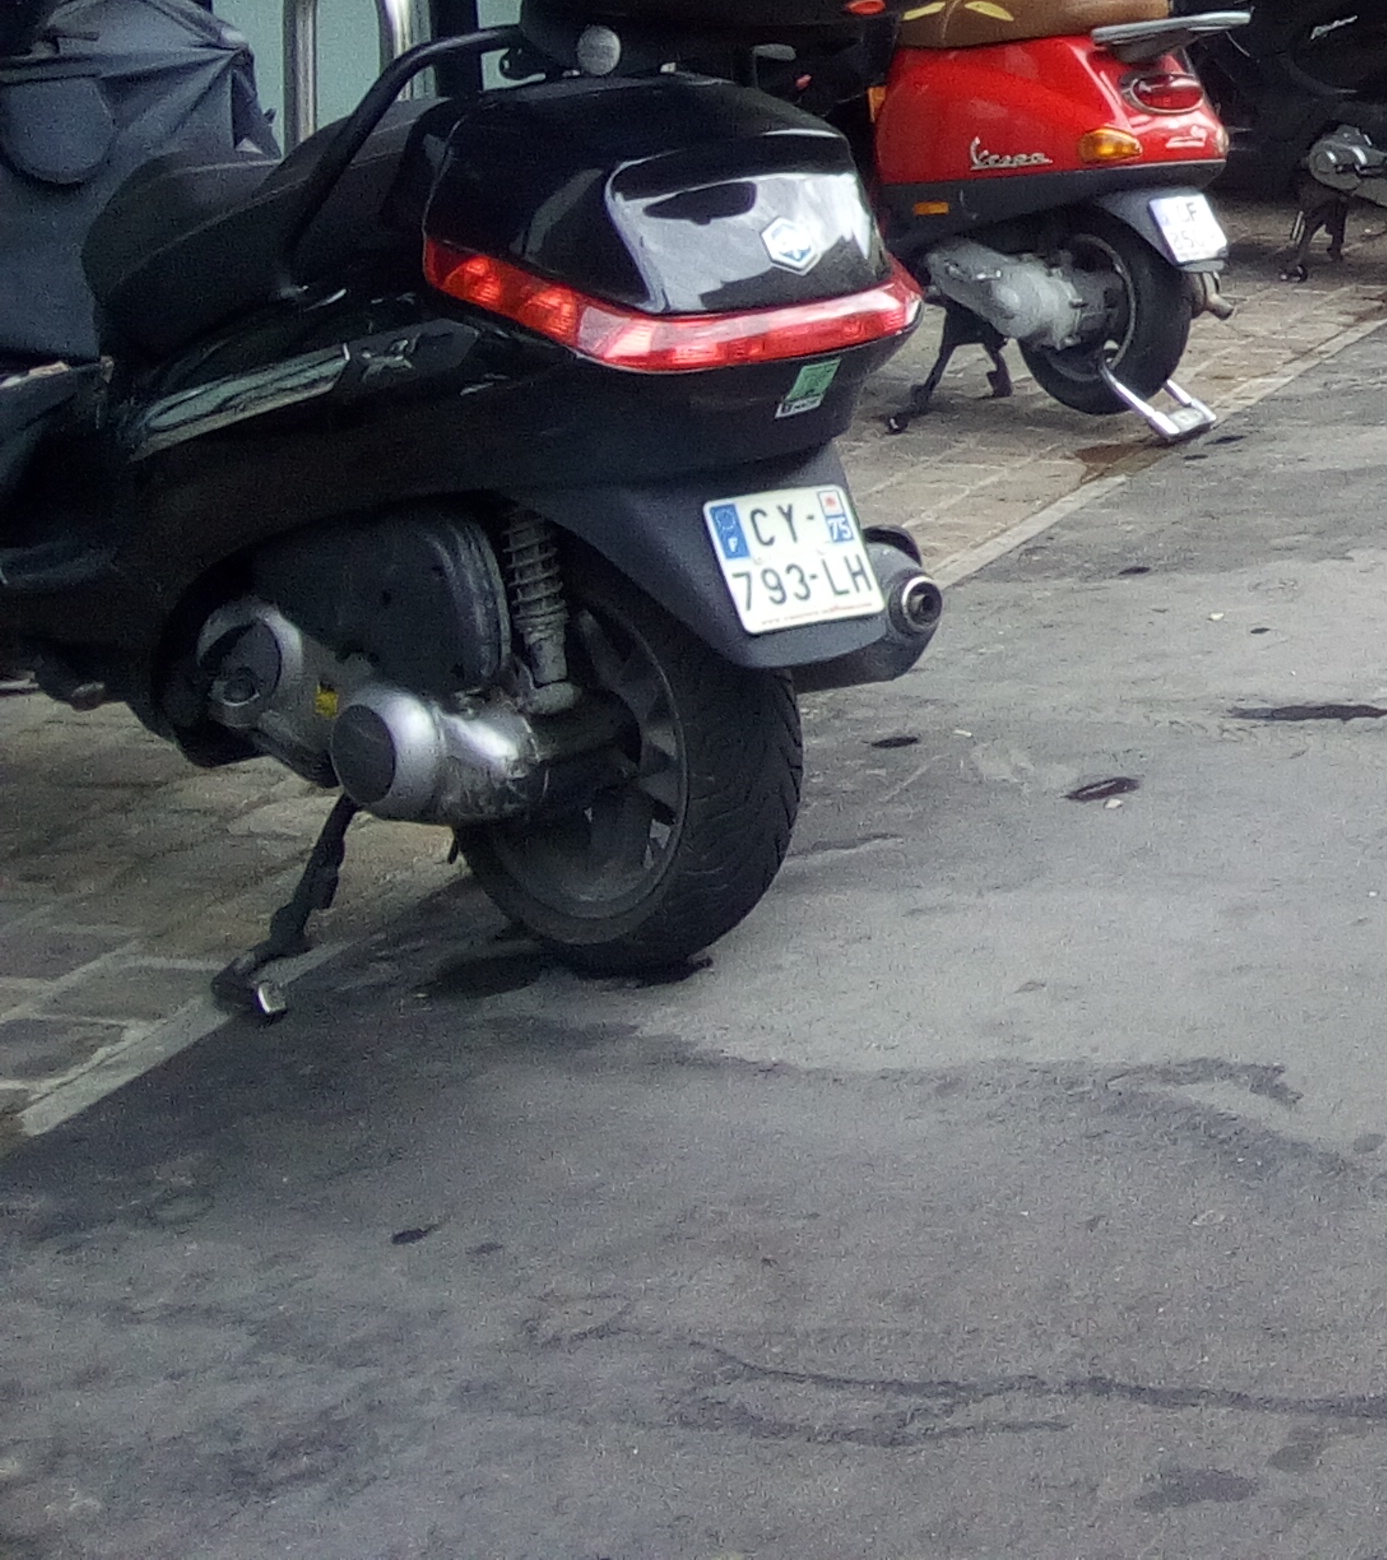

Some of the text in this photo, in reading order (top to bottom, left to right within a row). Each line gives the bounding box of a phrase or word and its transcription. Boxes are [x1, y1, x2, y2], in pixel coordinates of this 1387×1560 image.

[969, 136, 1054, 172] Vespa
[827, 516, 853, 541] 75
[732, 554, 873, 612] 793-LH
